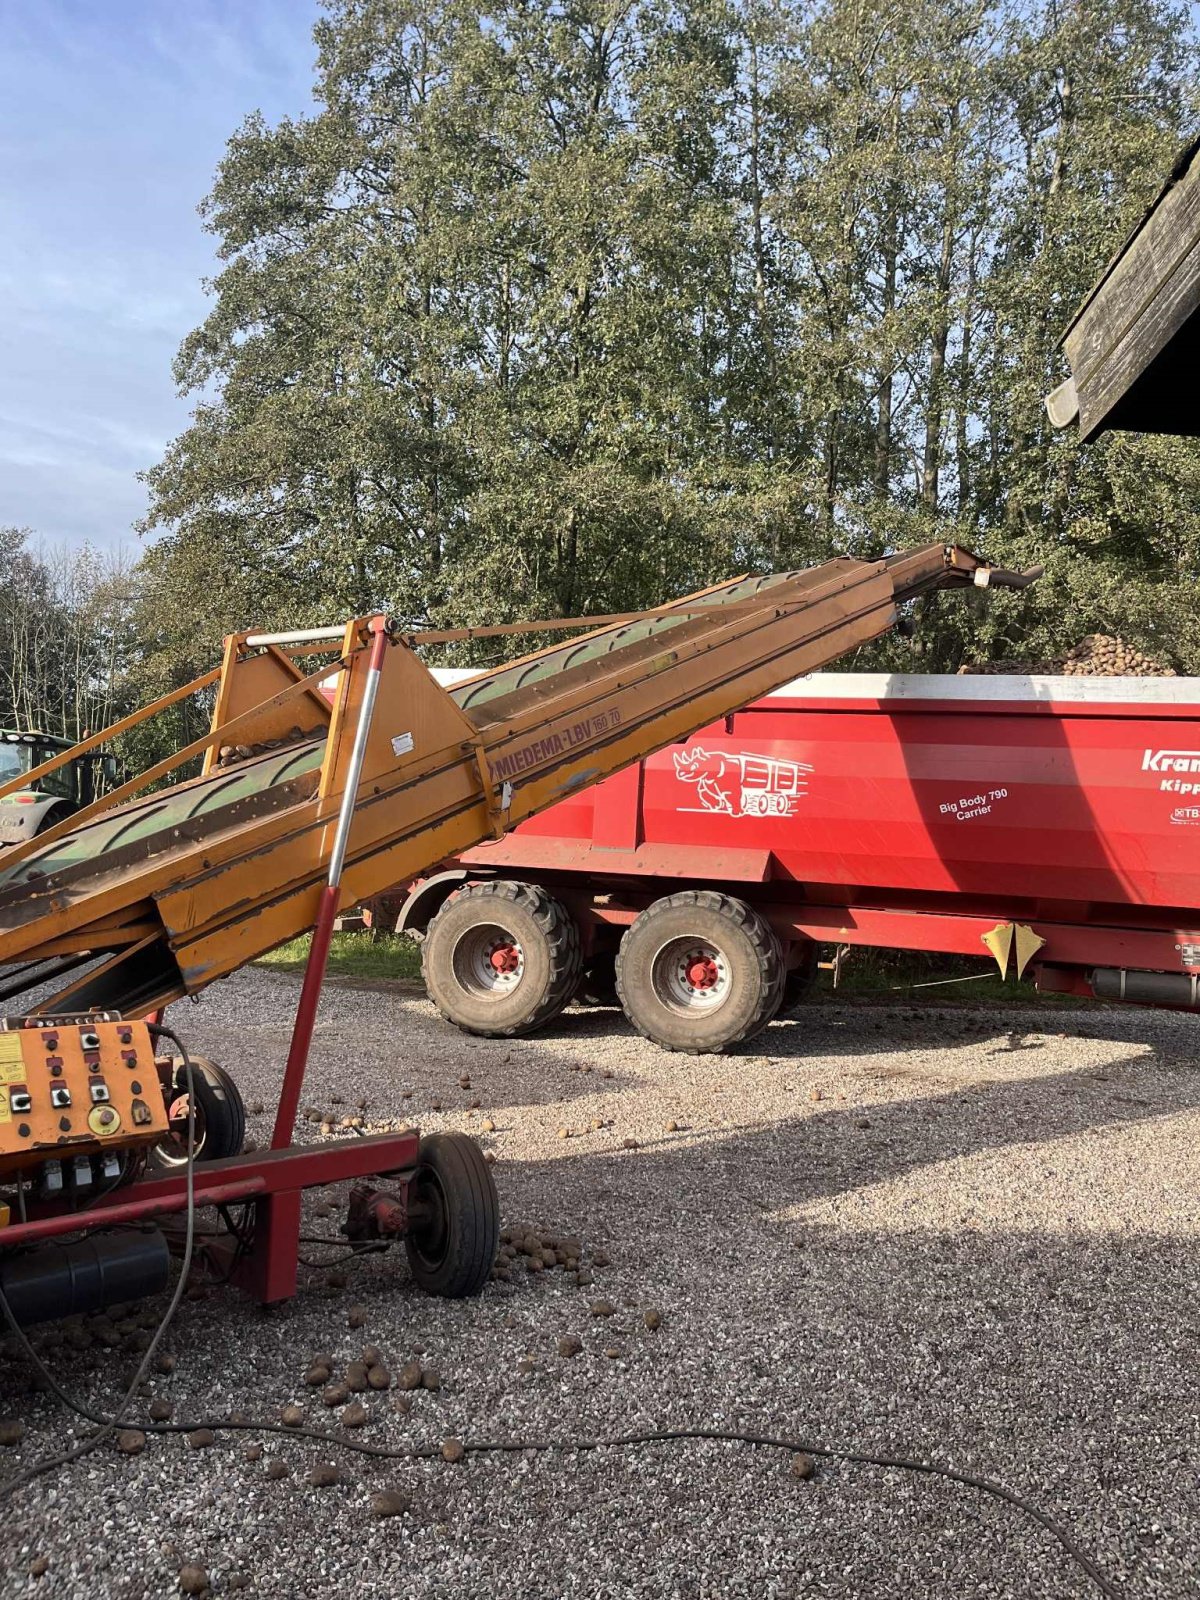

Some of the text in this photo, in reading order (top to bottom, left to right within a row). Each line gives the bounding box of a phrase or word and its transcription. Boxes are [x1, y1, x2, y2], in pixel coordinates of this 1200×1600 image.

[939, 788, 1008, 813] Big Body 790
[956, 805, 992, 820] Carrier
